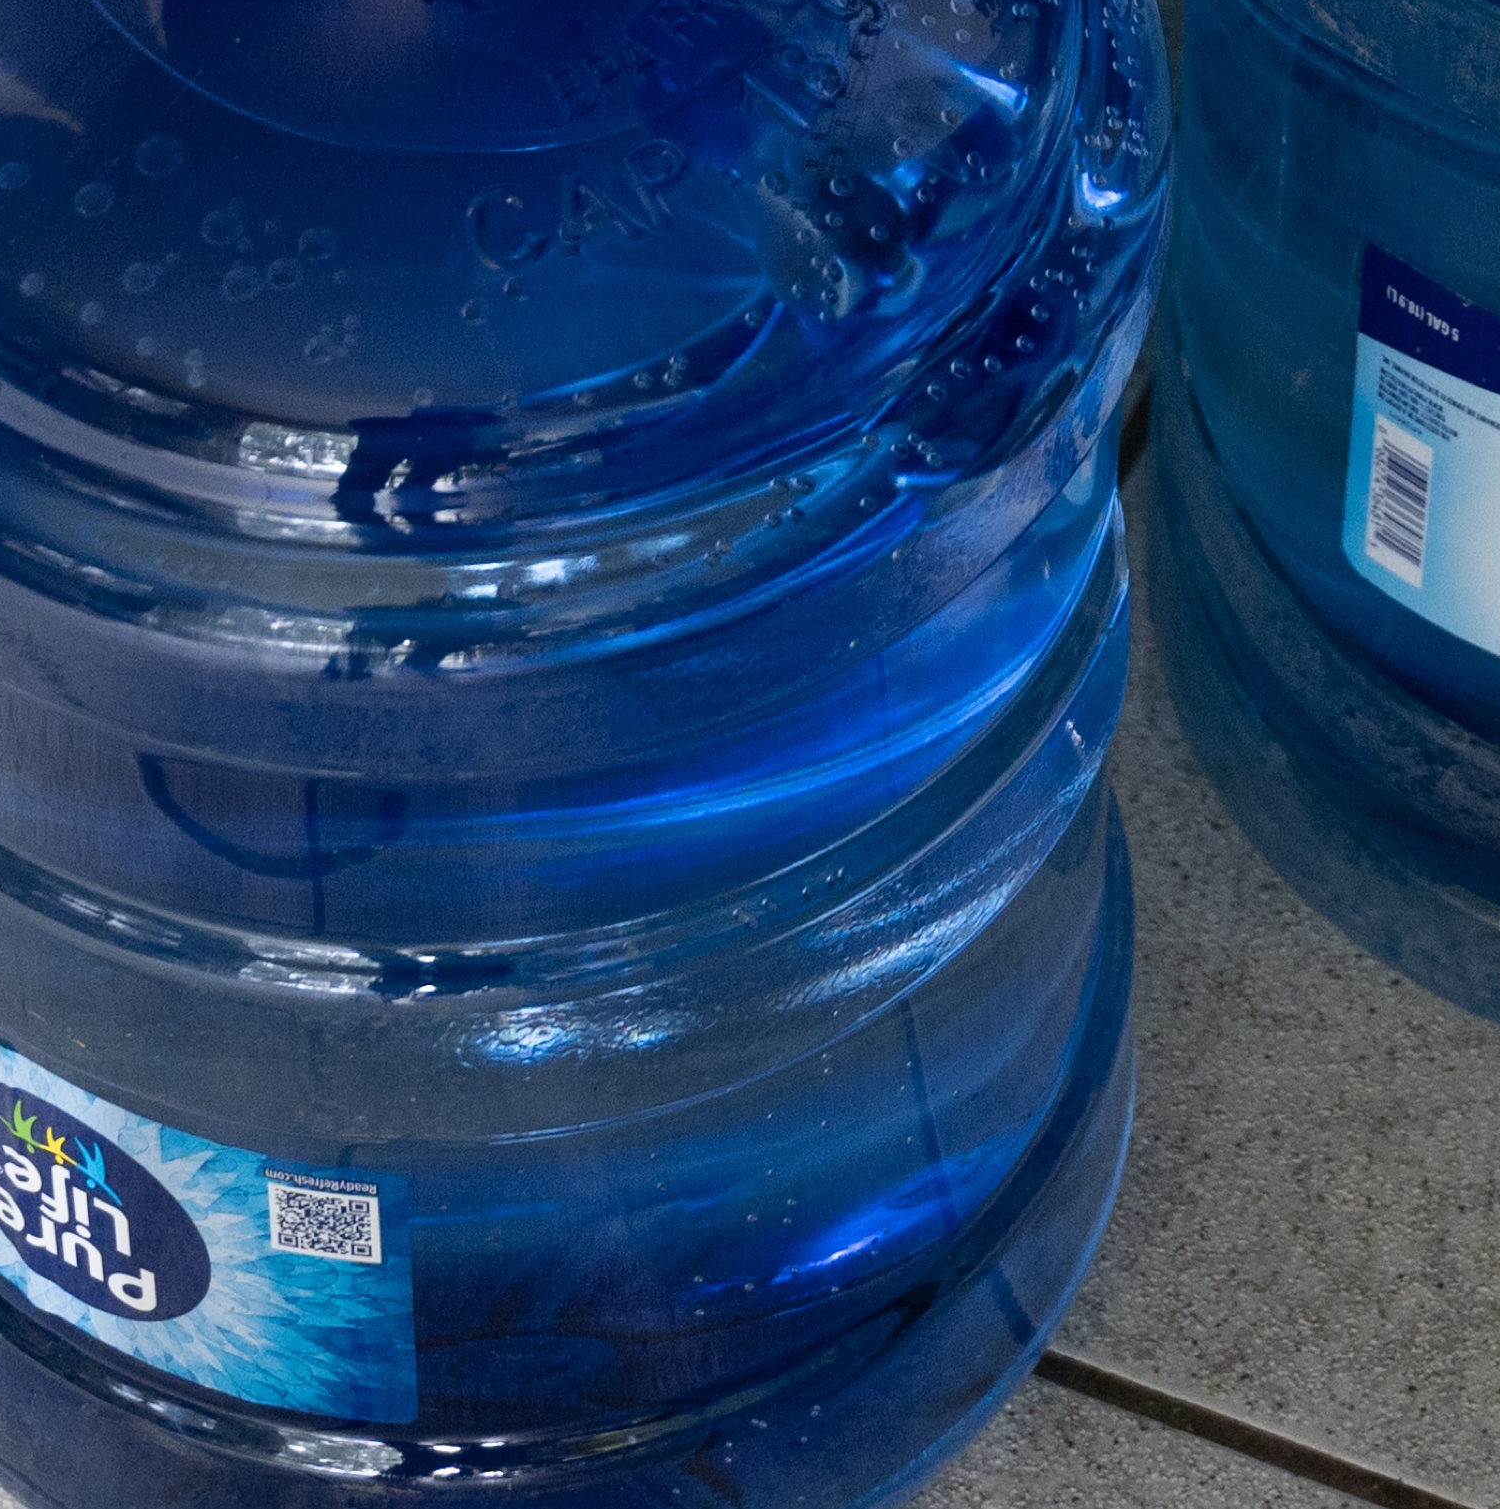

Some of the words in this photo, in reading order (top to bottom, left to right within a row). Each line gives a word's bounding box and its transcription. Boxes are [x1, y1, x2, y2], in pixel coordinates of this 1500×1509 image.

[1424, 310, 1451, 339] GAL
[1449, 326, 1461, 344] 5
[264, 1168, 378, 1195] ReadyRefresh.com
[1, 1143, 132, 1257] Life
